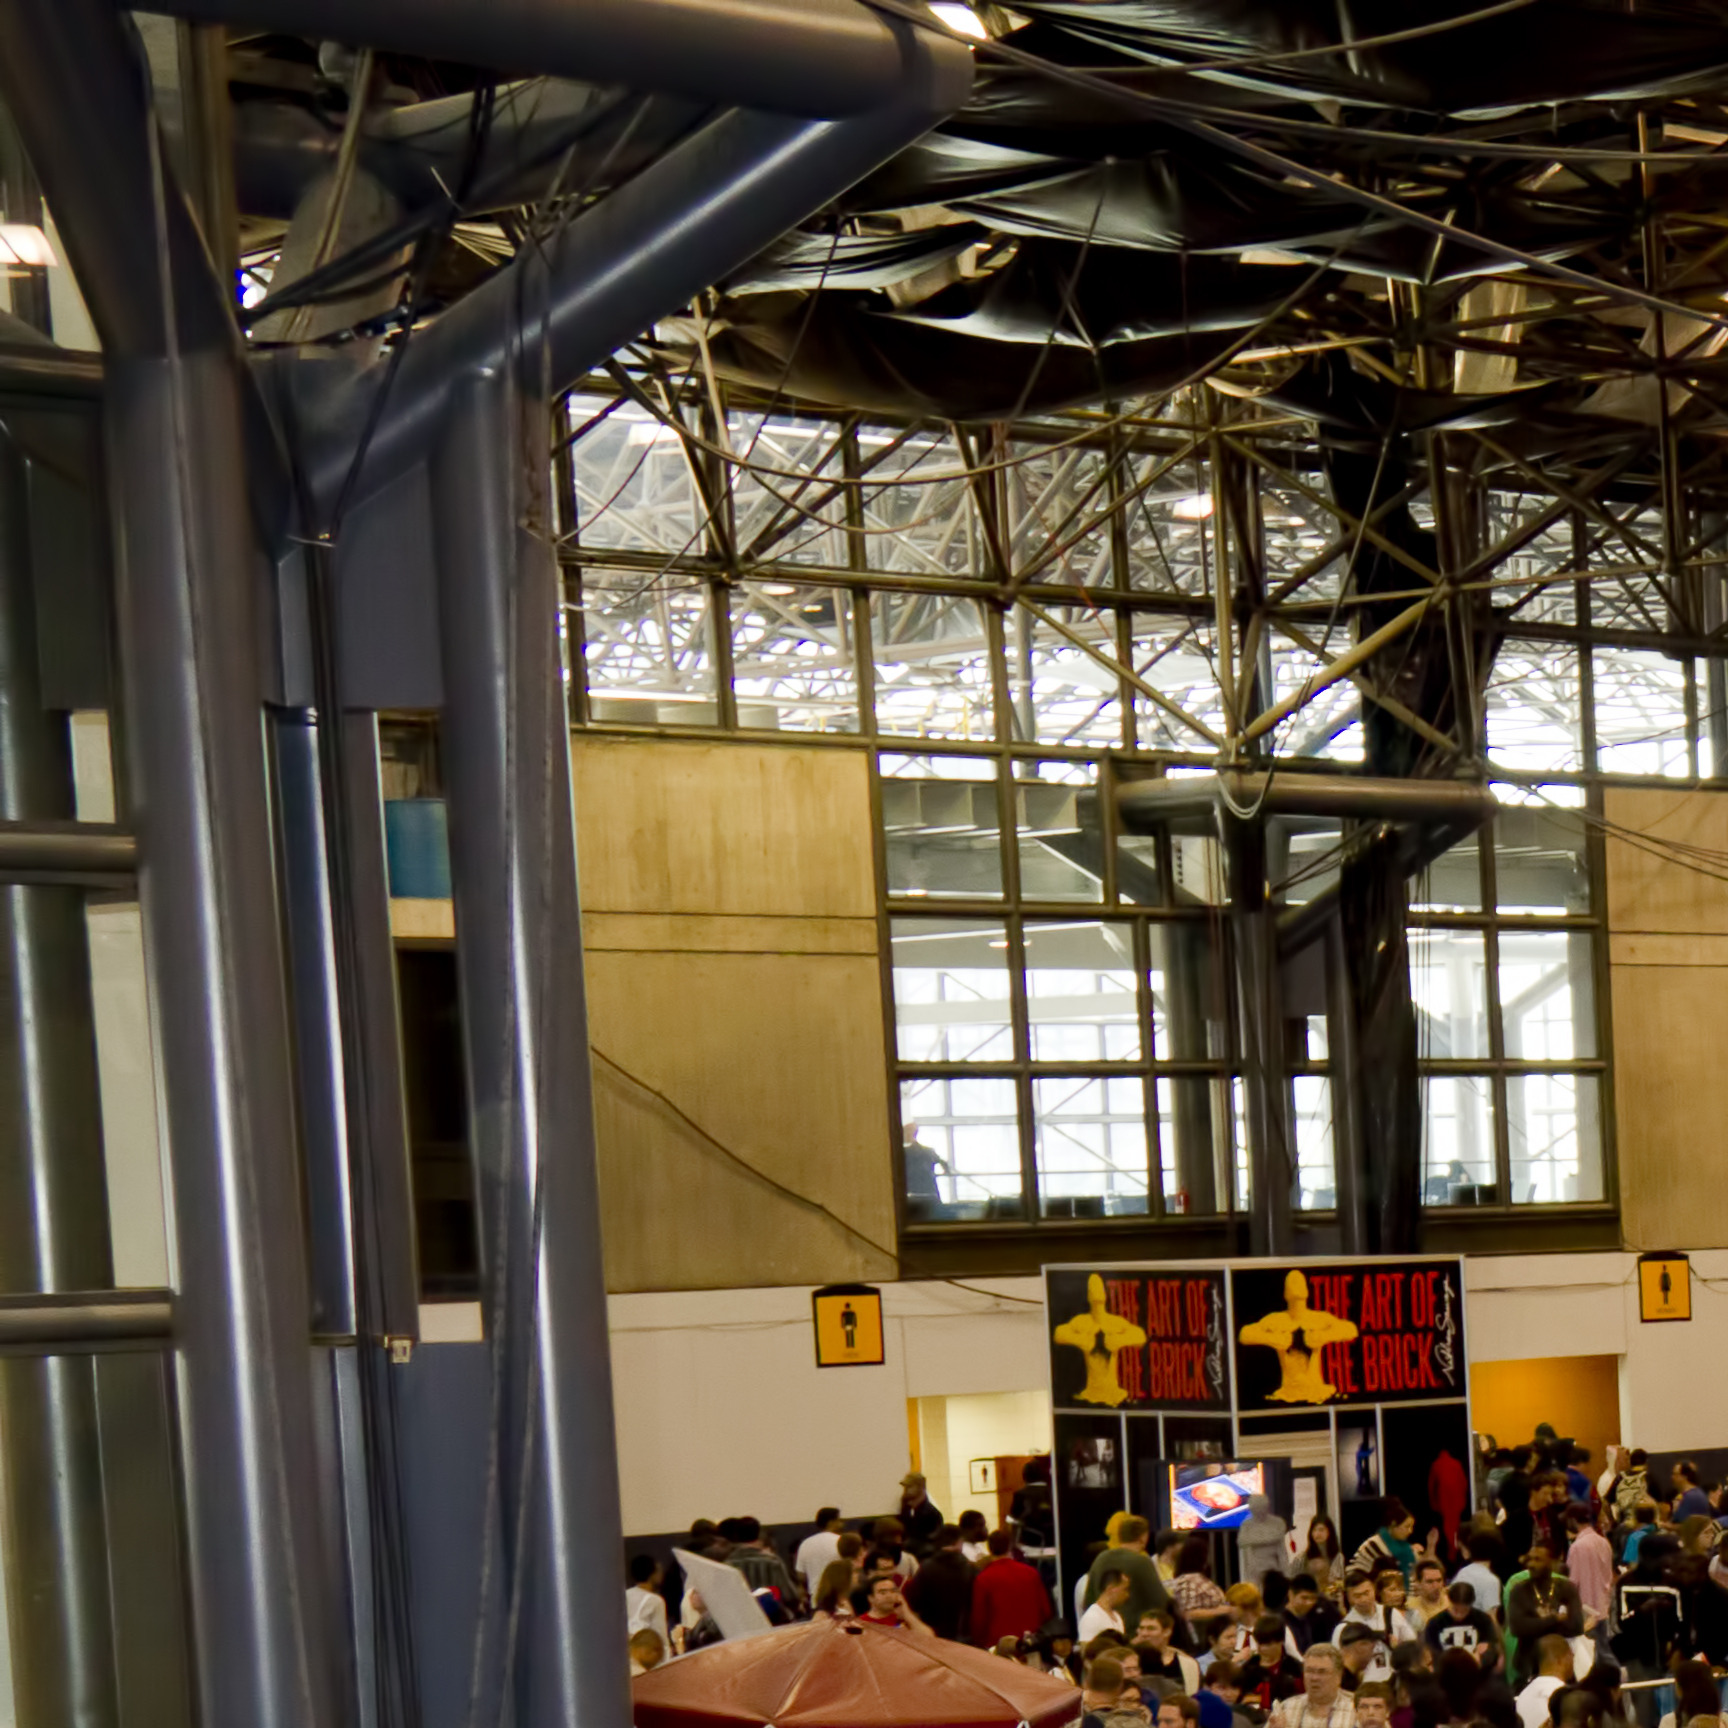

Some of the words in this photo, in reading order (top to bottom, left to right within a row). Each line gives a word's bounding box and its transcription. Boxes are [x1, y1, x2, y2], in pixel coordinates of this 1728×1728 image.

[1147, 1280, 1181, 1336] ART
[1184, 1279, 1209, 1336] OF
[1361, 1273, 1404, 1331] ART
[1410, 1271, 1439, 1328] OF
[1118, 1346, 1147, 1399] HE
[1149, 1340, 1209, 1399] BRICK
[1322, 1341, 1358, 1393] HE
[1363, 1332, 1439, 1391] BRICK
